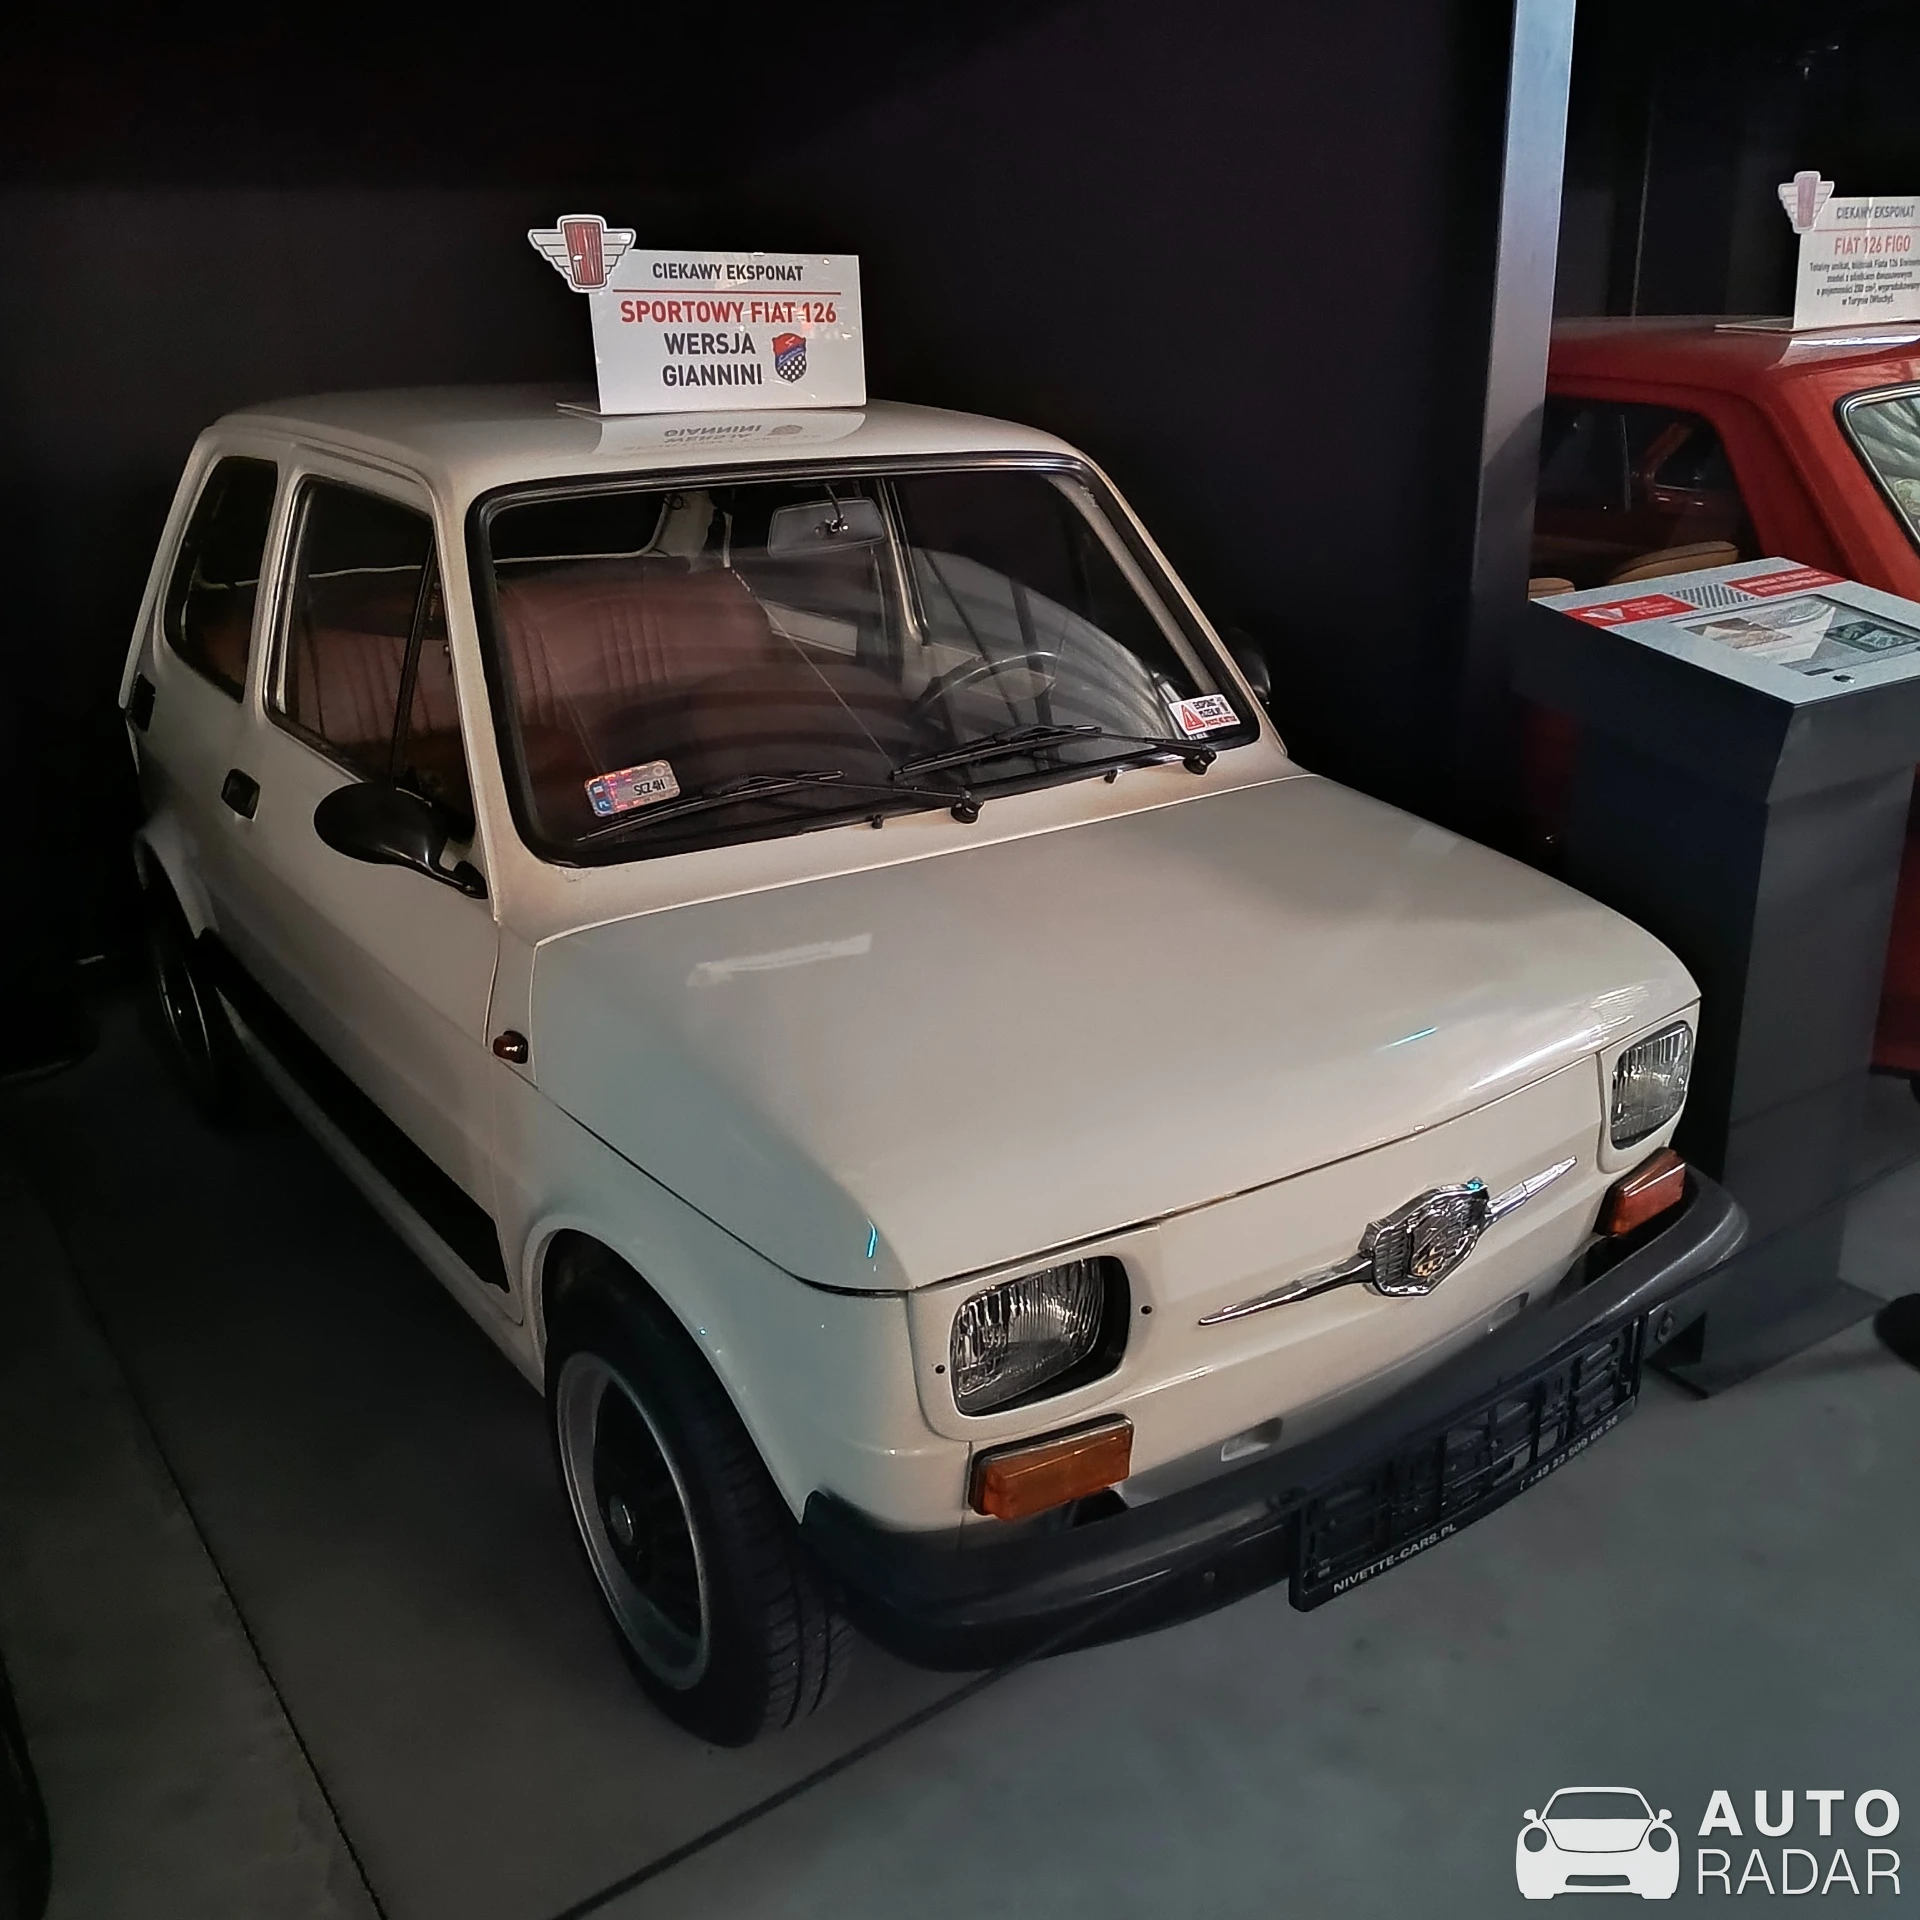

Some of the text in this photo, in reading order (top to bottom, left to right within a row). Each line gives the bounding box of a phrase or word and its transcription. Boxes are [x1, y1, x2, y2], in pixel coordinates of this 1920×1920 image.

[1875, 205, 1915, 218] EKSPONAT
[1835, 234, 1911, 255] FIAT 126 FIGO
[652, 262, 804, 281] CIEKAWY EKSPONAT
[620, 300, 837, 324] SPORTOWY FIAT 126
[664, 332, 757, 355] WERSJA
[662, 363, 763, 387] GIANNINI
[1333, 1523, 1457, 1593] NIVETTE-CARS.PL
